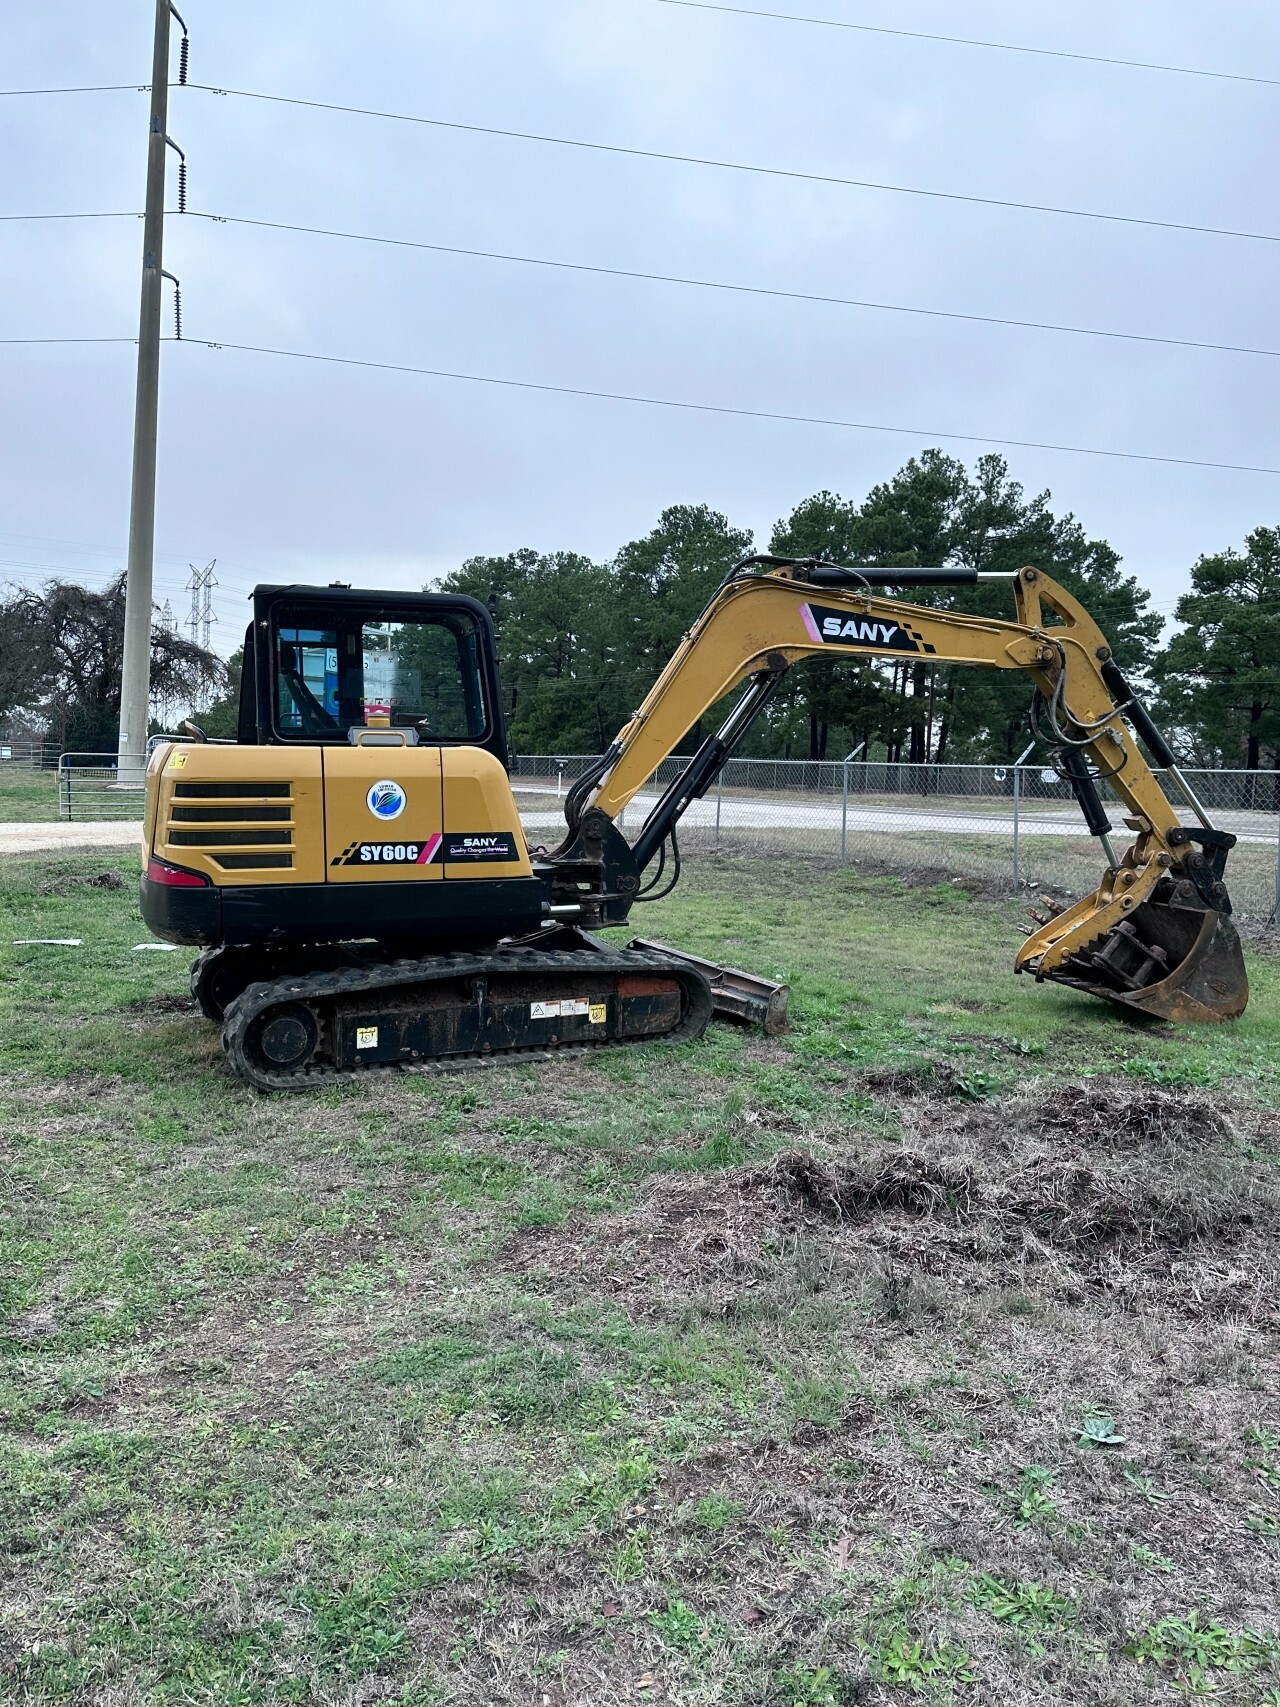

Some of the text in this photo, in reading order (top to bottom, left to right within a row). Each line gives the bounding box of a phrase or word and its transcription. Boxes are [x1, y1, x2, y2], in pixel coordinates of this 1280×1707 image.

[822, 617, 898, 643] SANY
[463, 838, 498, 847] SANY
[360, 845, 418, 861] SY60C
